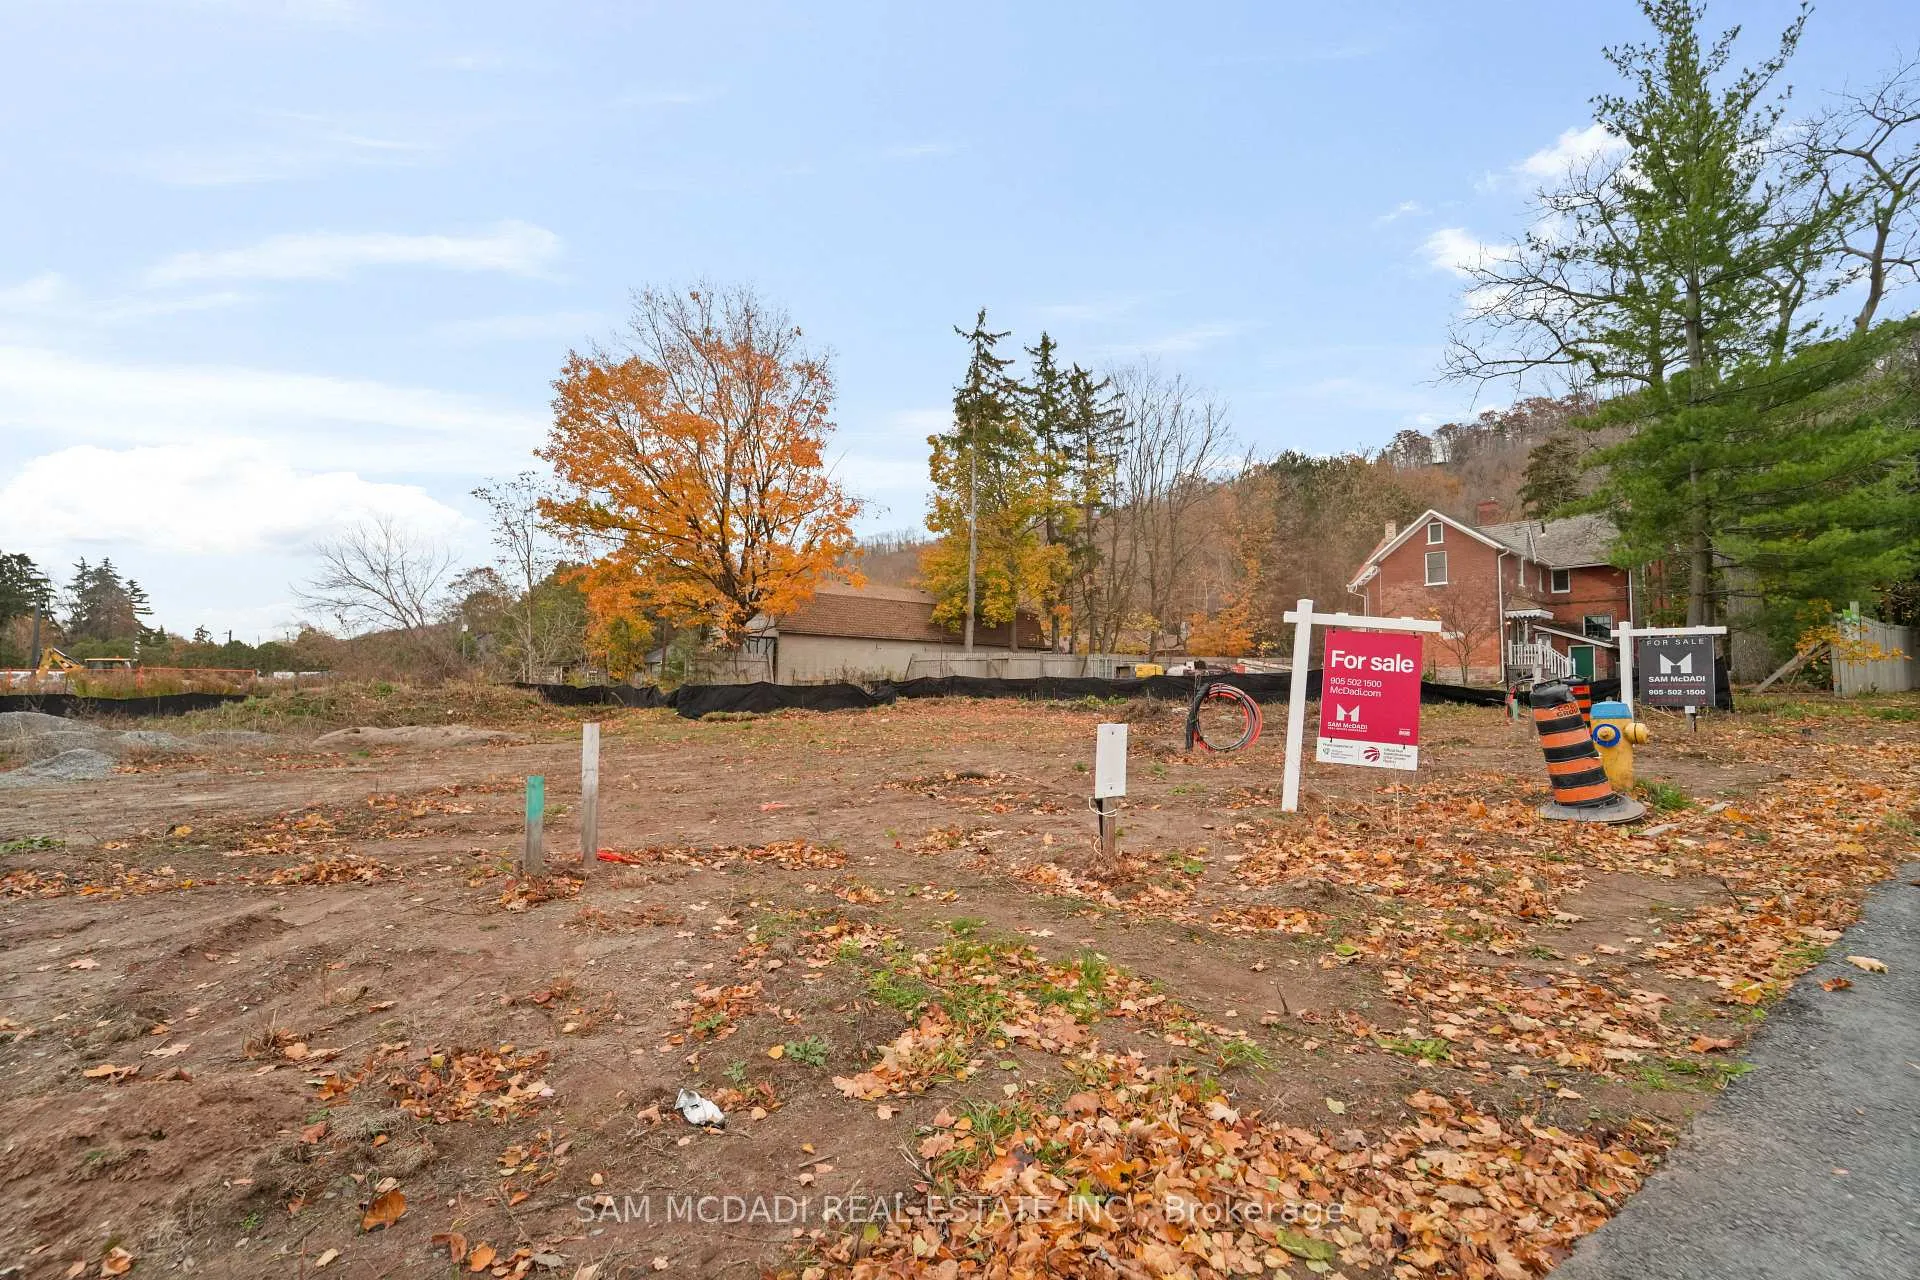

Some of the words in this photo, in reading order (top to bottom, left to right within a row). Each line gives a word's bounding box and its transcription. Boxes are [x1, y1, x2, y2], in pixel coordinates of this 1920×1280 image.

[1331, 650, 1366, 669] For
[1370, 653, 1414, 673] sale
[1330, 677, 1346, 685] 905
[1347, 678, 1362, 687] 502
[1364, 679, 1382, 688] 1500
[1648, 675, 1668, 683] SAM
[1670, 675, 1706, 683] McDADI
